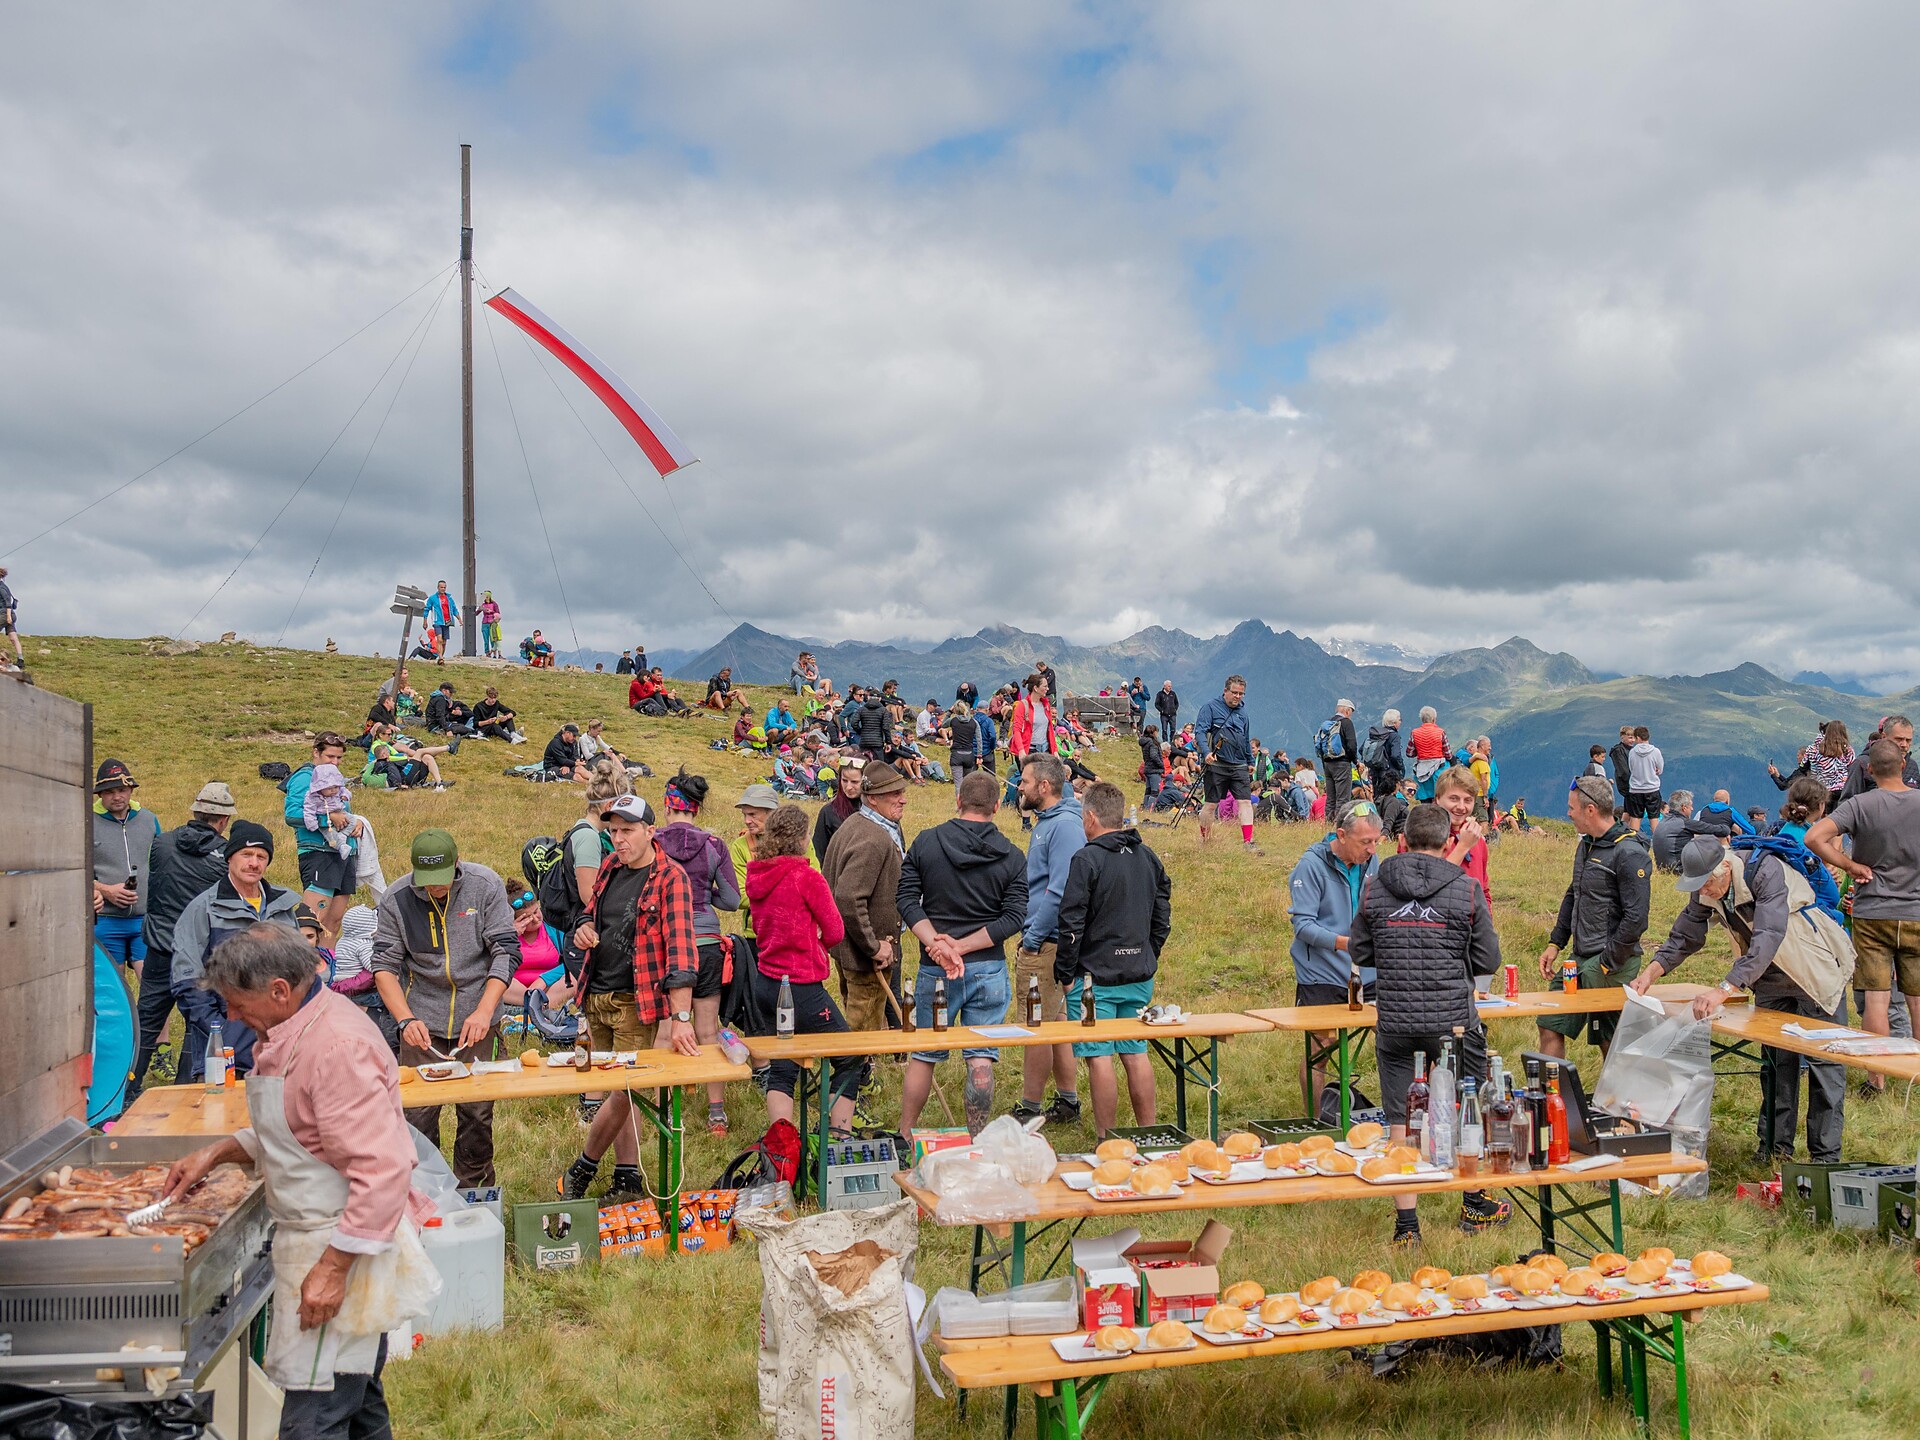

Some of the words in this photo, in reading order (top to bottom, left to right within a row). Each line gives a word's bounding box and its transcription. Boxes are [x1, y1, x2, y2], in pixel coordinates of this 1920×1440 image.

[1563, 967, 1577, 976] FANT
[682, 1236, 705, 1246] FANTA
[541, 1250, 576, 1262] FORST
[1098, 1305, 1122, 1314] SENAPE
